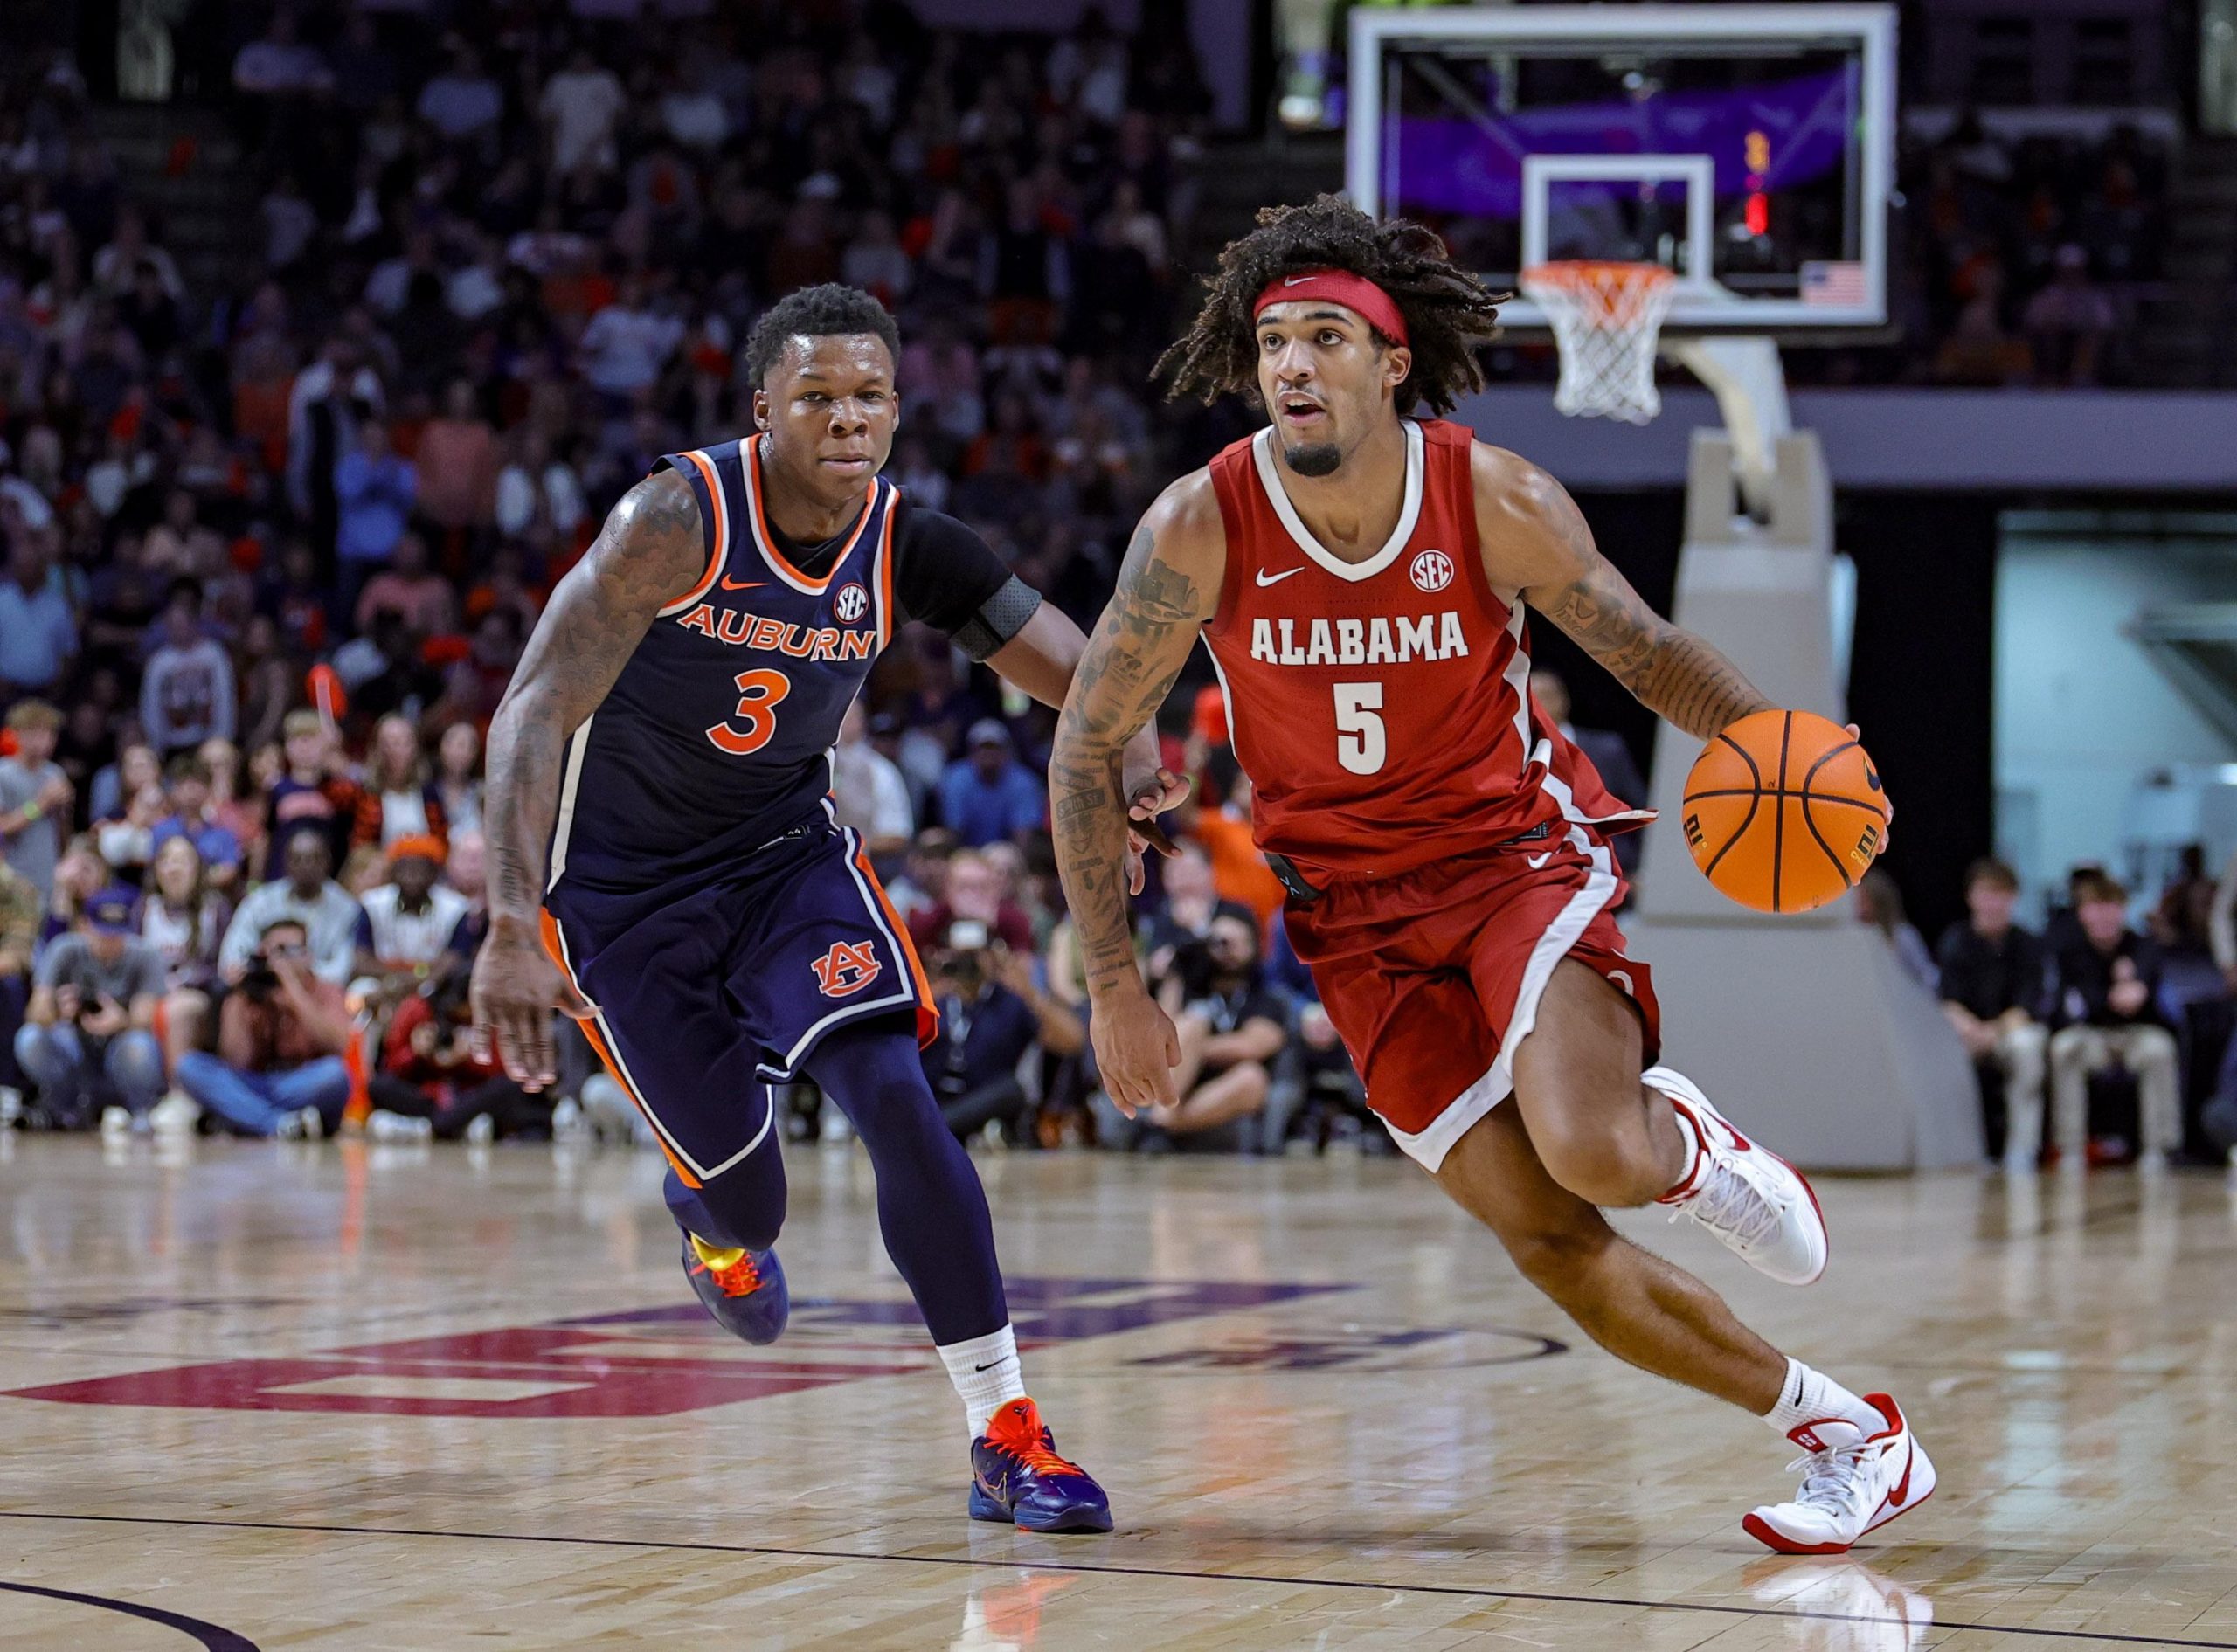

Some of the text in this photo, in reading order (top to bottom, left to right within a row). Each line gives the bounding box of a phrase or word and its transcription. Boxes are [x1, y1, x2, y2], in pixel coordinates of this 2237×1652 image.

[1413, 552, 1450, 590] SEC
[676, 603, 877, 662] AUBURN
[836, 585, 866, 621] SEC
[1250, 611, 1469, 665] ALABAMA
[705, 667, 791, 756] 3
[1333, 681, 1387, 776] 5
[810, 939, 883, 998] AU
